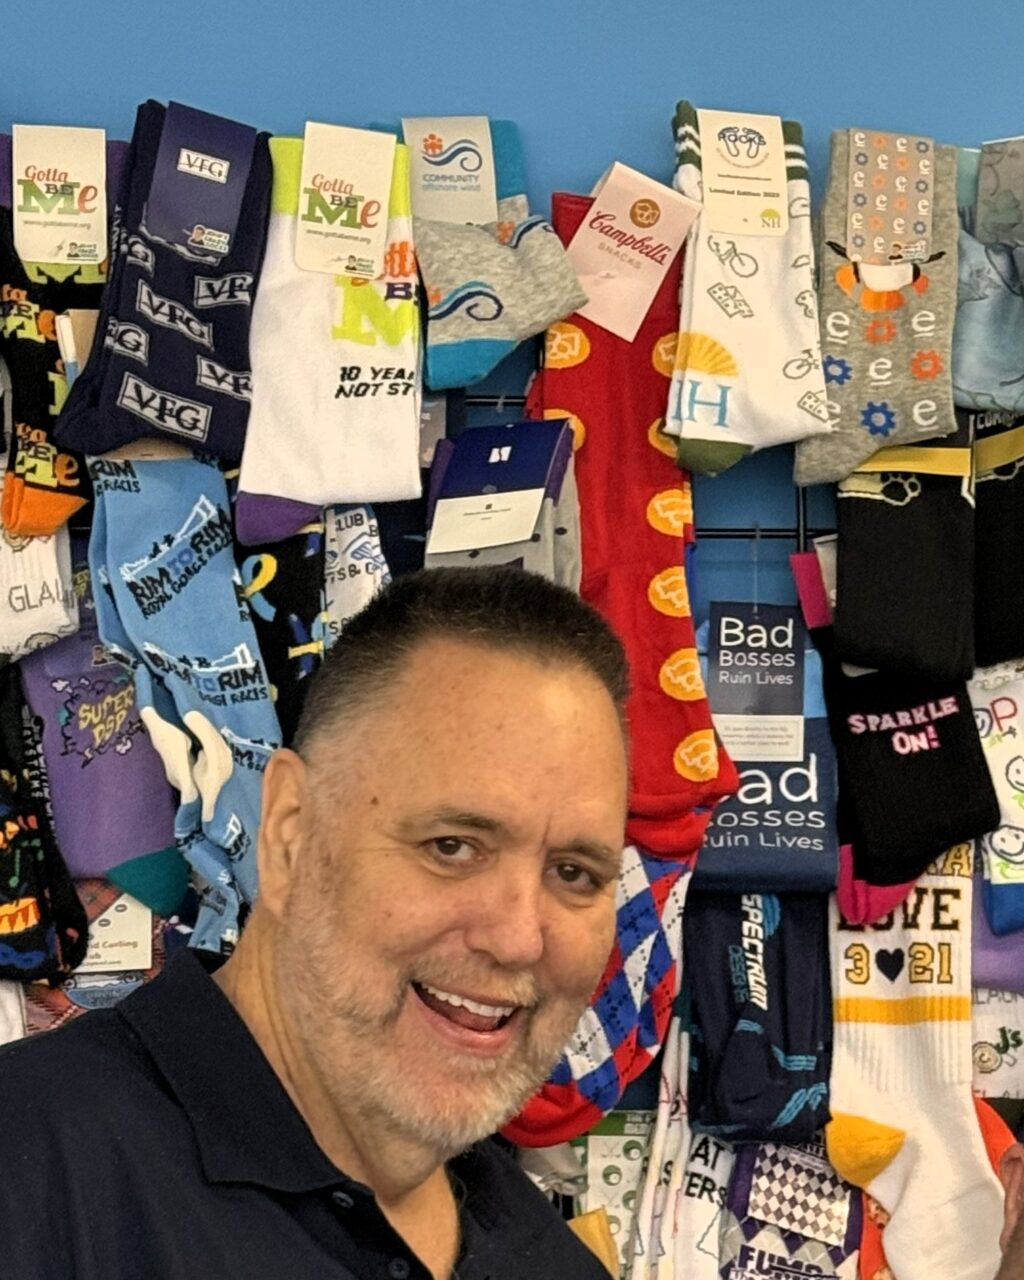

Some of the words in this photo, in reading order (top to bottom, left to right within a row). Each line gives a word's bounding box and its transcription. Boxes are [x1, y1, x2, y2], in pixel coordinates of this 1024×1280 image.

[25, 164, 68, 183] Gotta
[185, 152, 224, 179] VFG
[423, 174, 479, 183] COMMUNITY
[17, 178, 98, 215] Me
[312, 173, 354, 195] Gotta
[708, 187, 735, 195] Limited
[301, 187, 381, 230] Me
[329, 193, 359, 209] BE
[588, 211, 672, 266] Campbell's
[597, 241, 642, 269] SNACKS
[145, 288, 207, 341] VFG
[340, 366, 361, 382] 10
[334, 383, 380, 400] NOT
[387, 382, 414, 397] ST
[132, 381, 202, 432] VFG
[719, 616, 795, 649] Bad
[719, 650, 796, 668] Bosses
[217, 660, 264, 692] RIM
[718, 670, 751, 685] Ruin
[755, 670, 794, 686] Lives
[78, 685, 135, 729] SUPER
[847, 696, 959, 733] SPARKLE
[92, 706, 129, 747] DSP
[892, 725, 941, 755] ON!
[737, 752, 818, 805] ad
[709, 810, 826, 829] osses
[759, 831, 825, 851] Lives
[741, 894, 769, 1012] SPECTRUM
[844, 942, 871, 985] 3
[908, 942, 954, 985] 21
